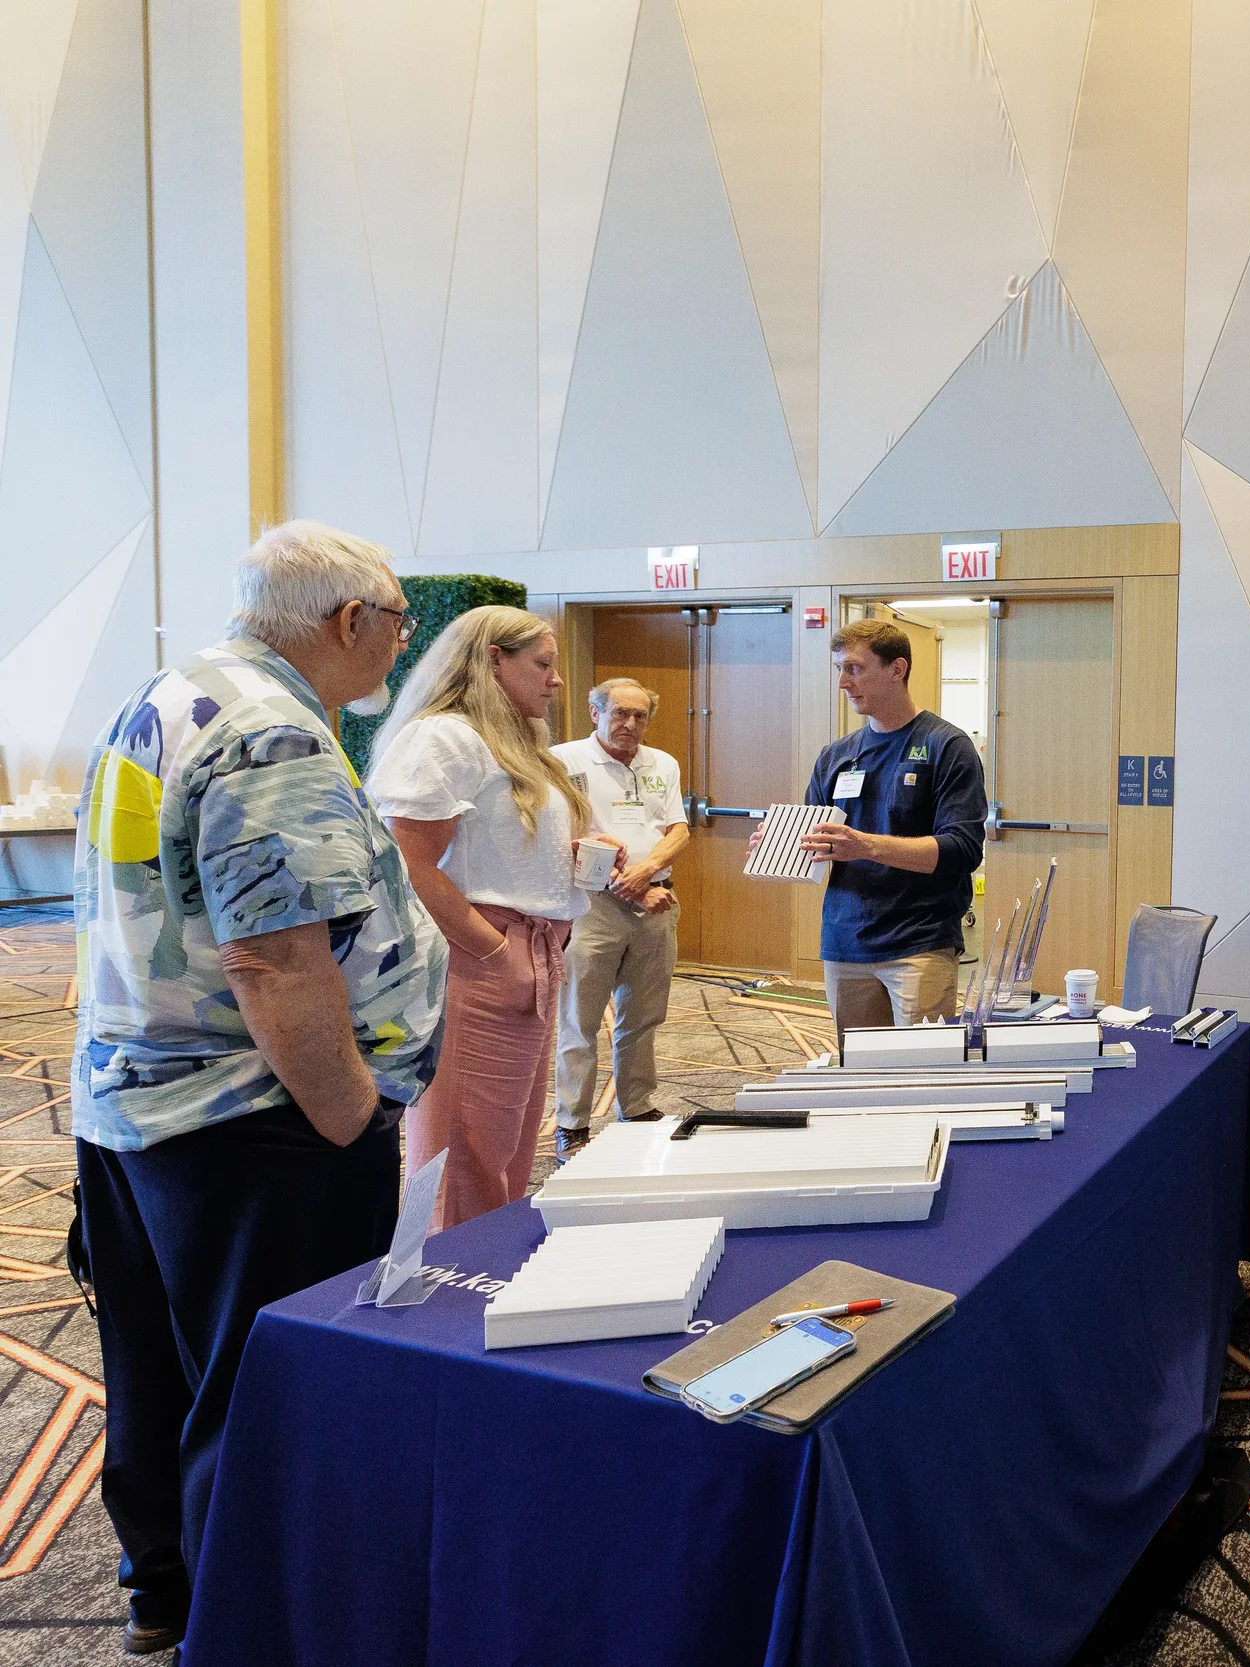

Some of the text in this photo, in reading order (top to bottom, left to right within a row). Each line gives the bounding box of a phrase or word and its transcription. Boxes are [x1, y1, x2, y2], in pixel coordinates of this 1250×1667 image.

[654, 563, 688, 589] EXIT
[948, 550, 990, 579] EXIT
[1127, 759, 1135, 770] K
